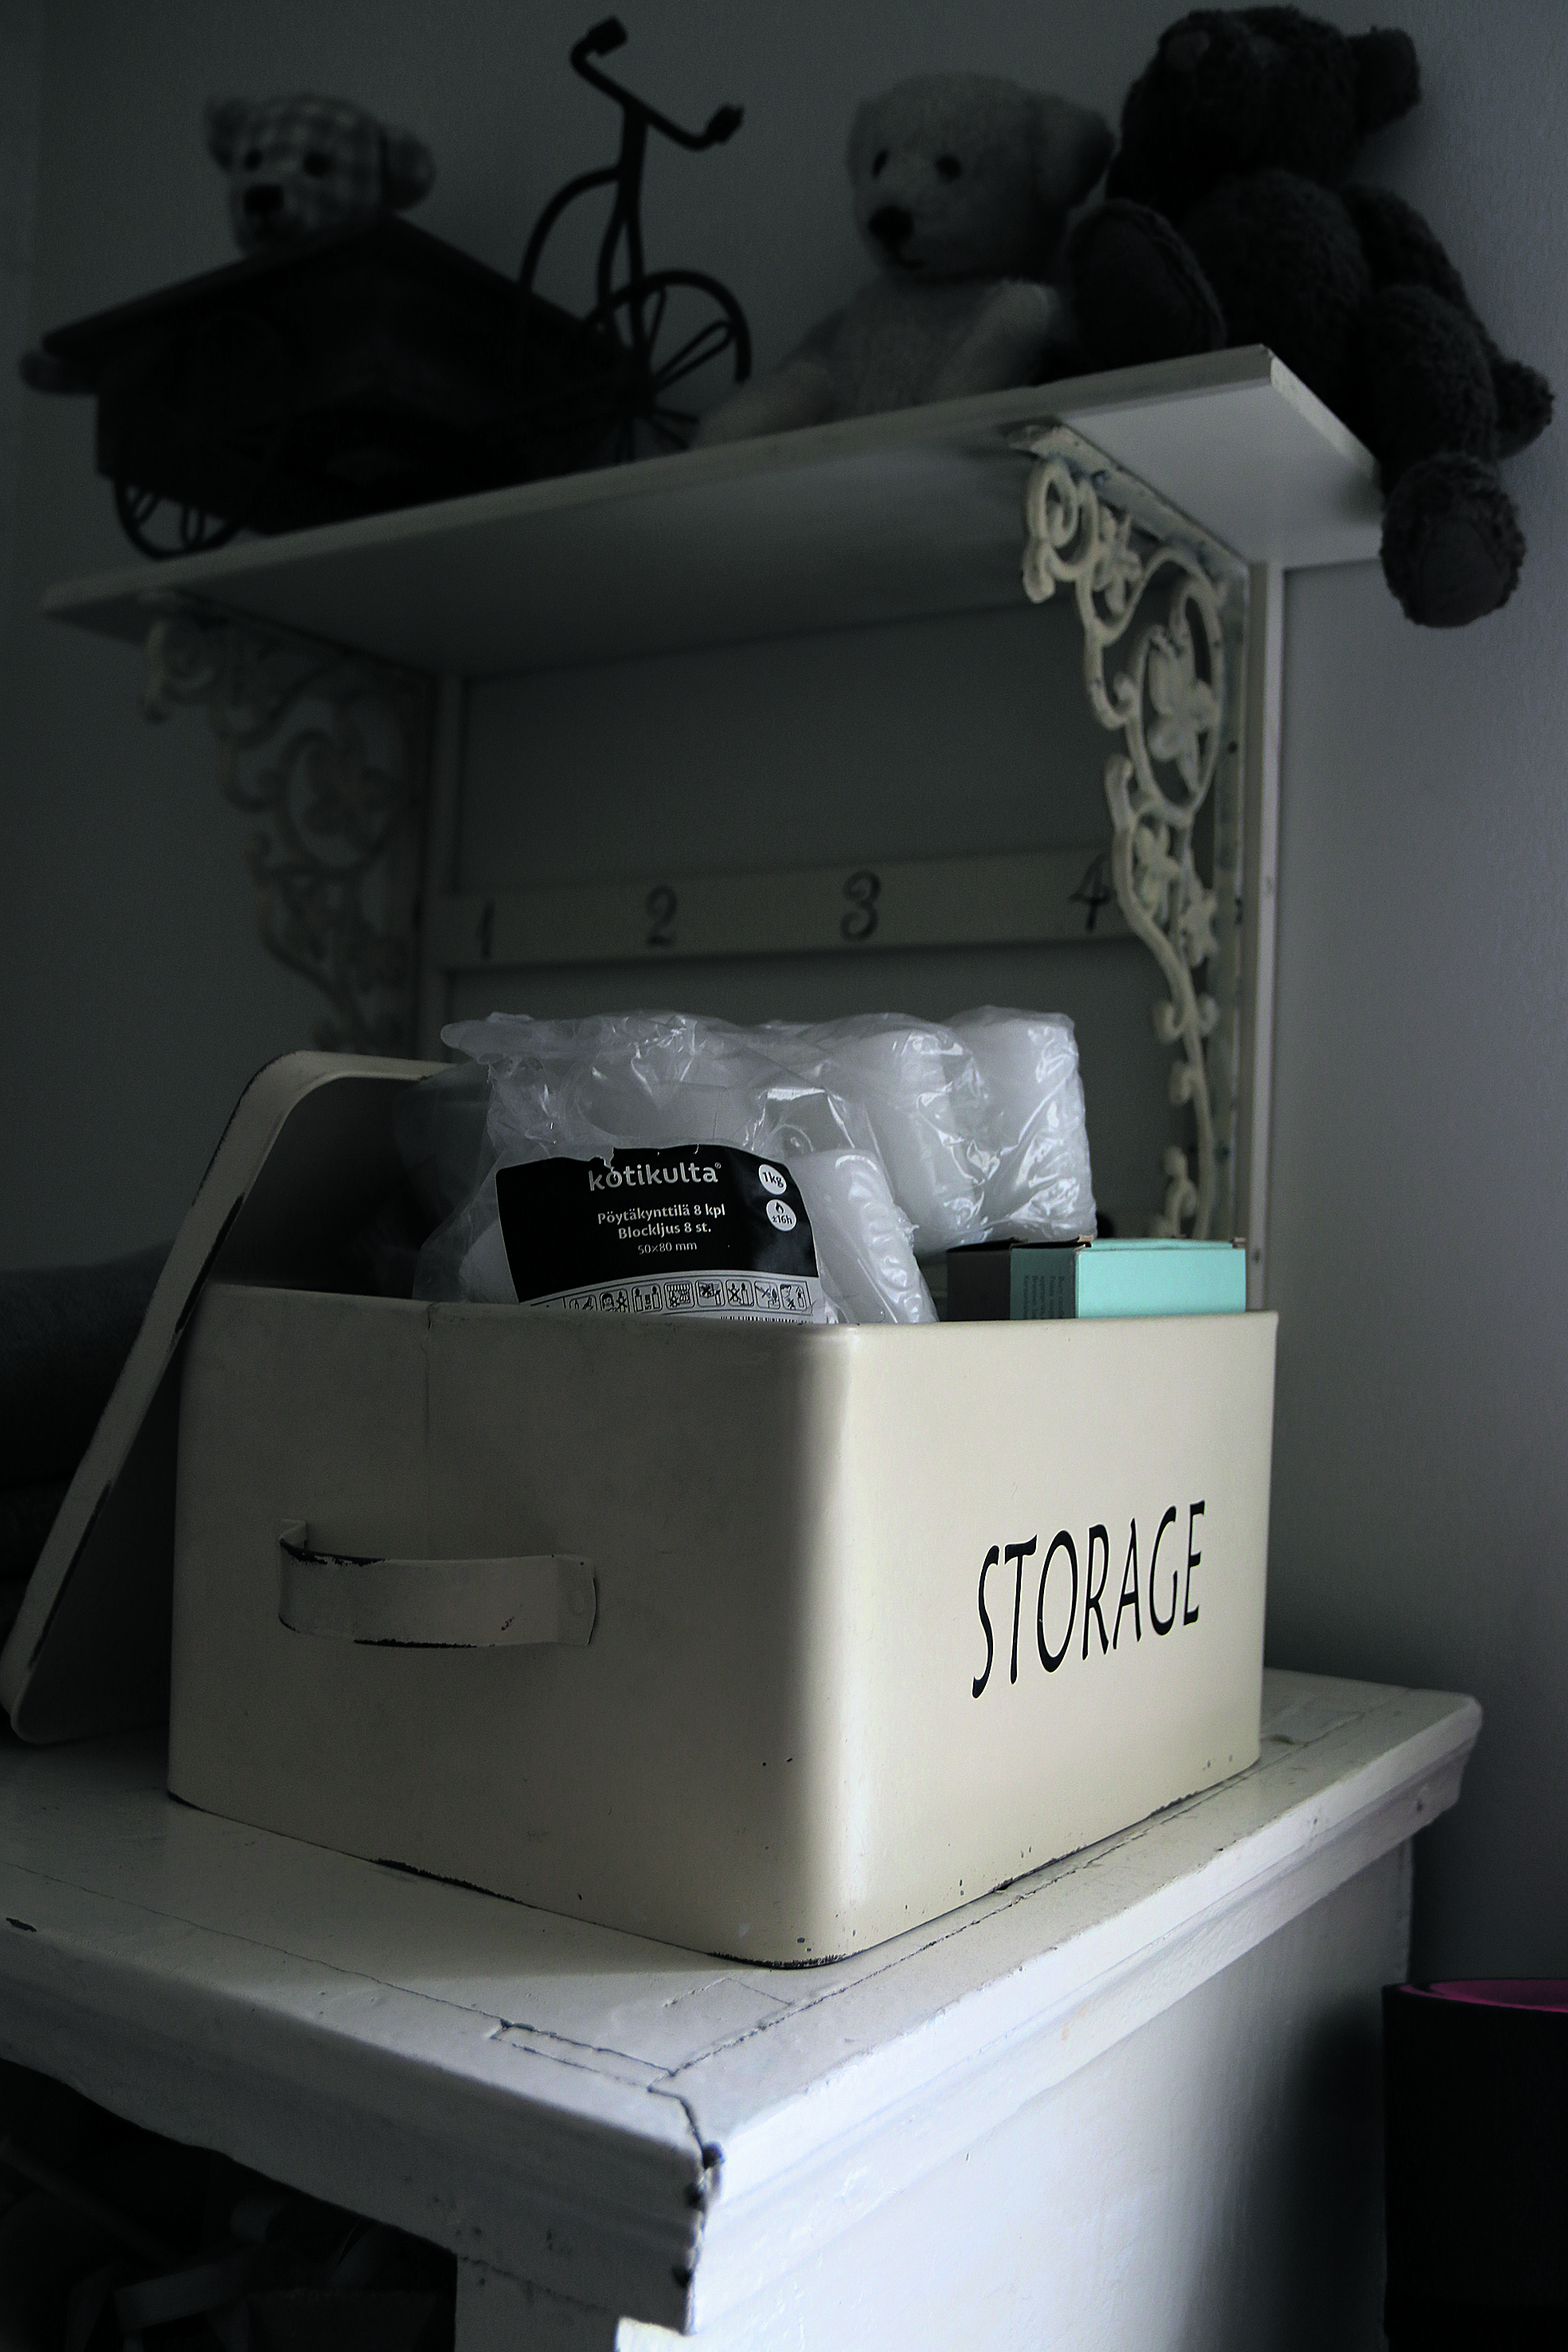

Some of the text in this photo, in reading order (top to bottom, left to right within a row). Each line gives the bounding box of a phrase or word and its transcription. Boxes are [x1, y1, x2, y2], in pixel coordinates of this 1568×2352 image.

[479, 852, 1116, 960] 1 2 3 4
[597, 1203, 725, 1225] Pöytäkynttilä 8 kpl
[618, 1222, 711, 1239] Blockljus 8 st.
[675, 1242, 698, 1251] mm
[972, 1500, 1205, 1699] STORAGE
